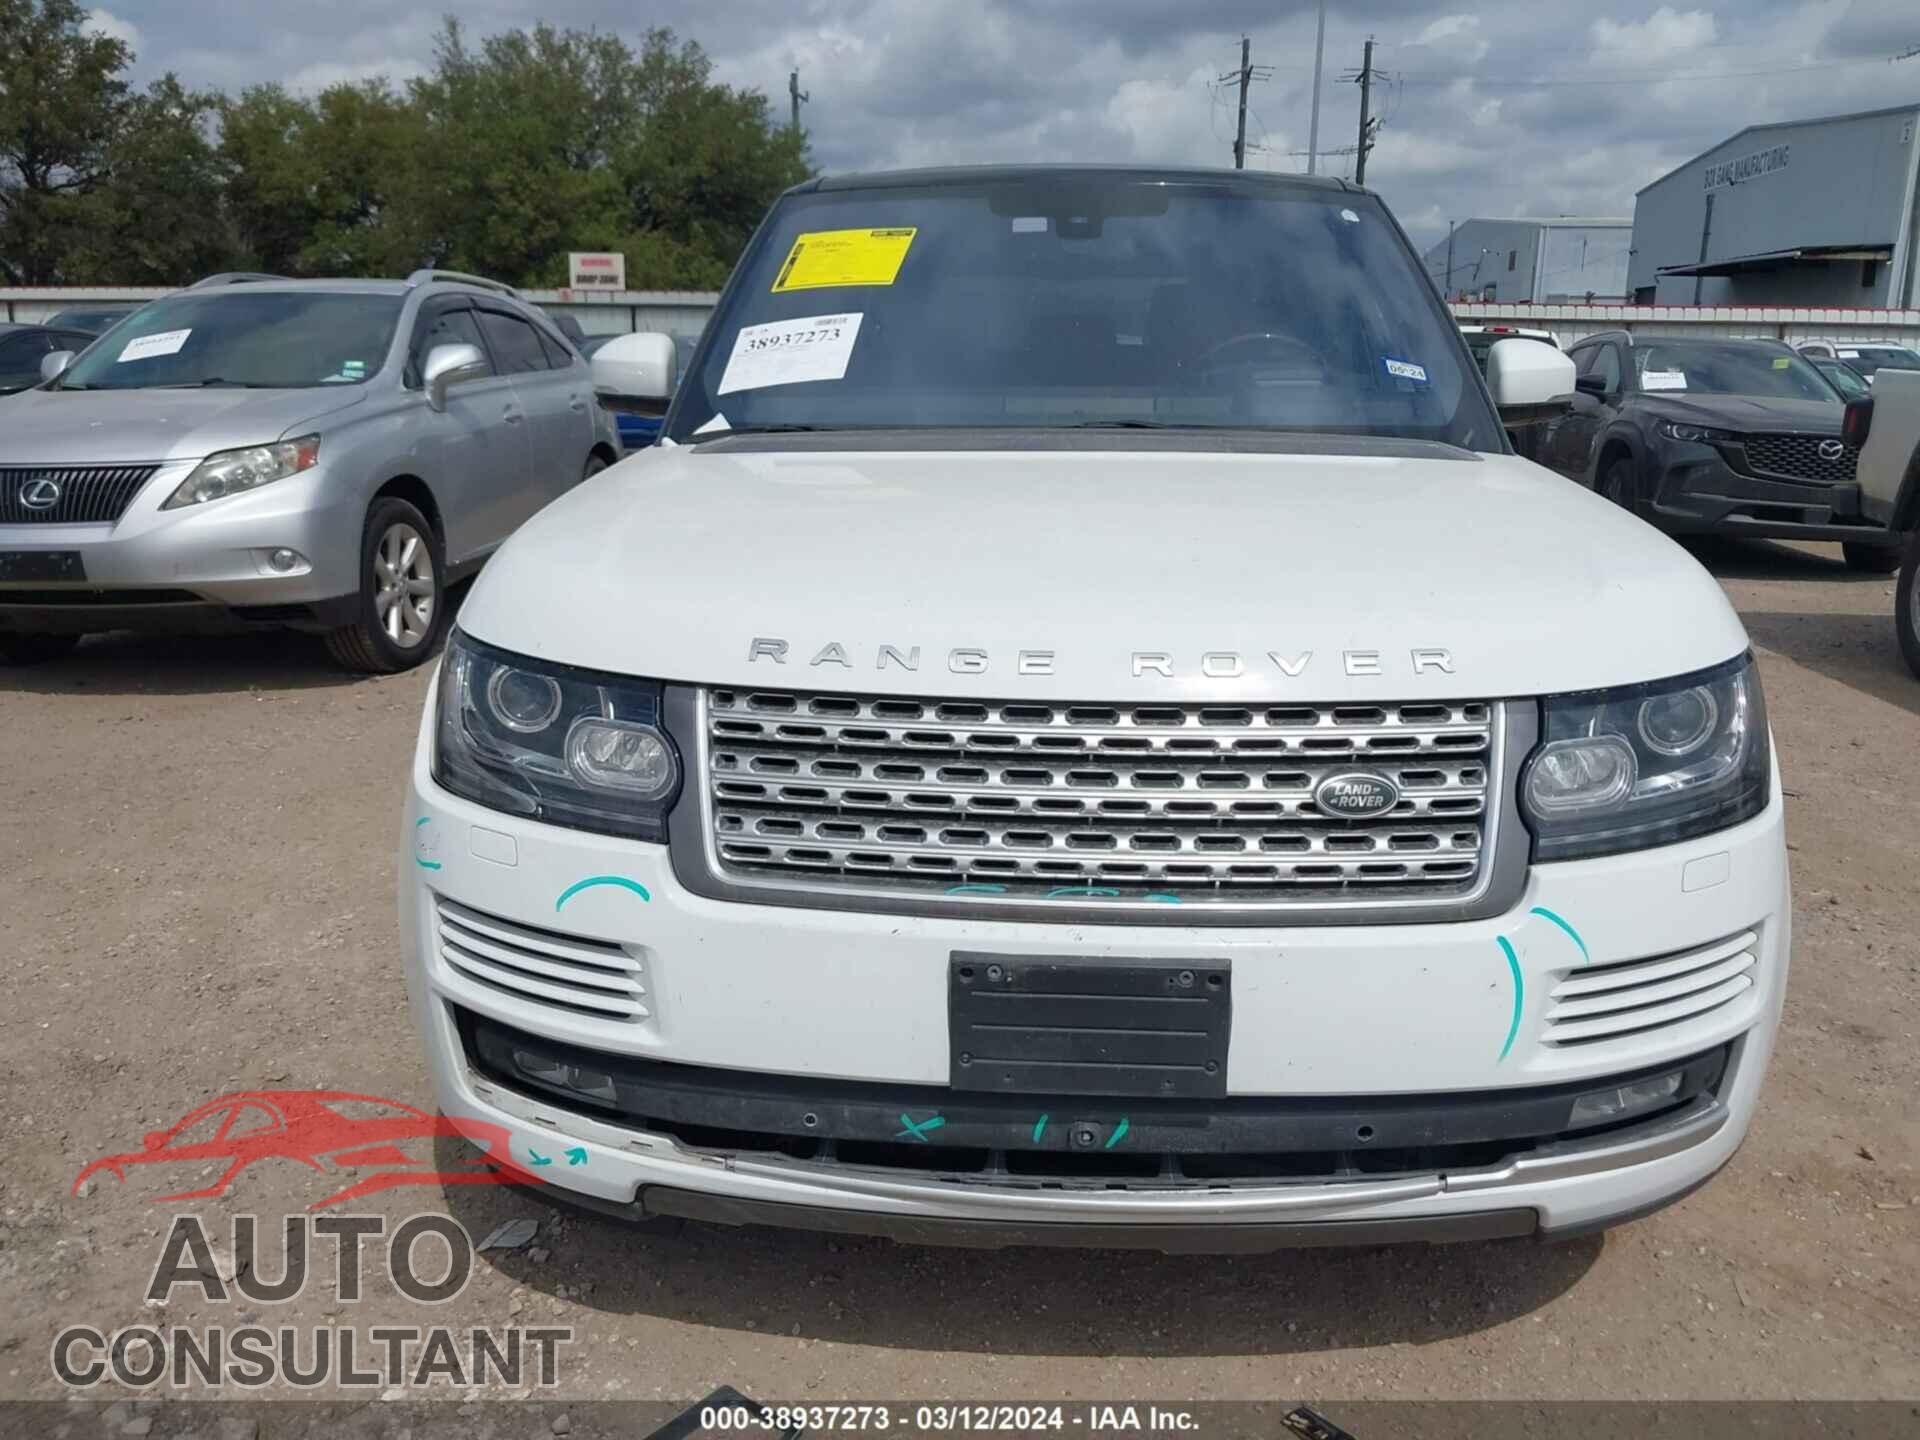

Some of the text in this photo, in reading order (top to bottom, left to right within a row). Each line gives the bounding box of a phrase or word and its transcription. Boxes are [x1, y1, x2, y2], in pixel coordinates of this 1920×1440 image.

[744, 328, 841, 353] 38937273
[748, 637, 1456, 677] RANGE ROVER
[1334, 784, 1372, 796] LAND
[1338, 795, 1384, 808] ROVER
